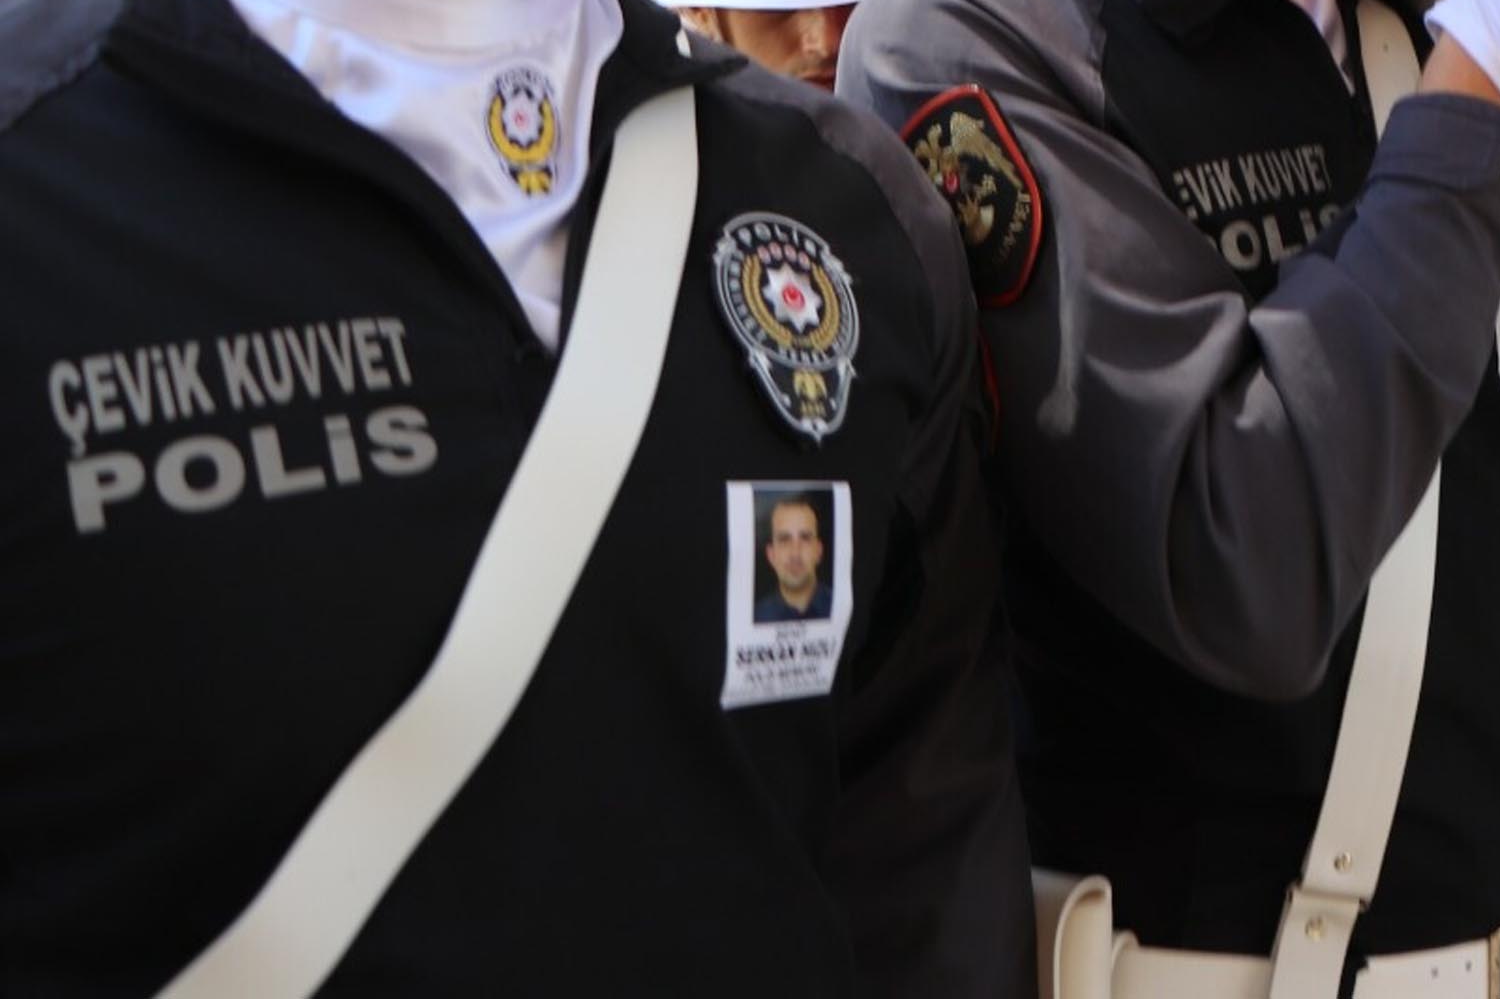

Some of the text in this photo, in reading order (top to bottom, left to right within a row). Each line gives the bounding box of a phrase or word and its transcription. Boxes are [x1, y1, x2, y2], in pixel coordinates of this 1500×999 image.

[1173, 144, 1333, 220] EVİK KUVVET
[217, 317, 413, 411] KUVVET
